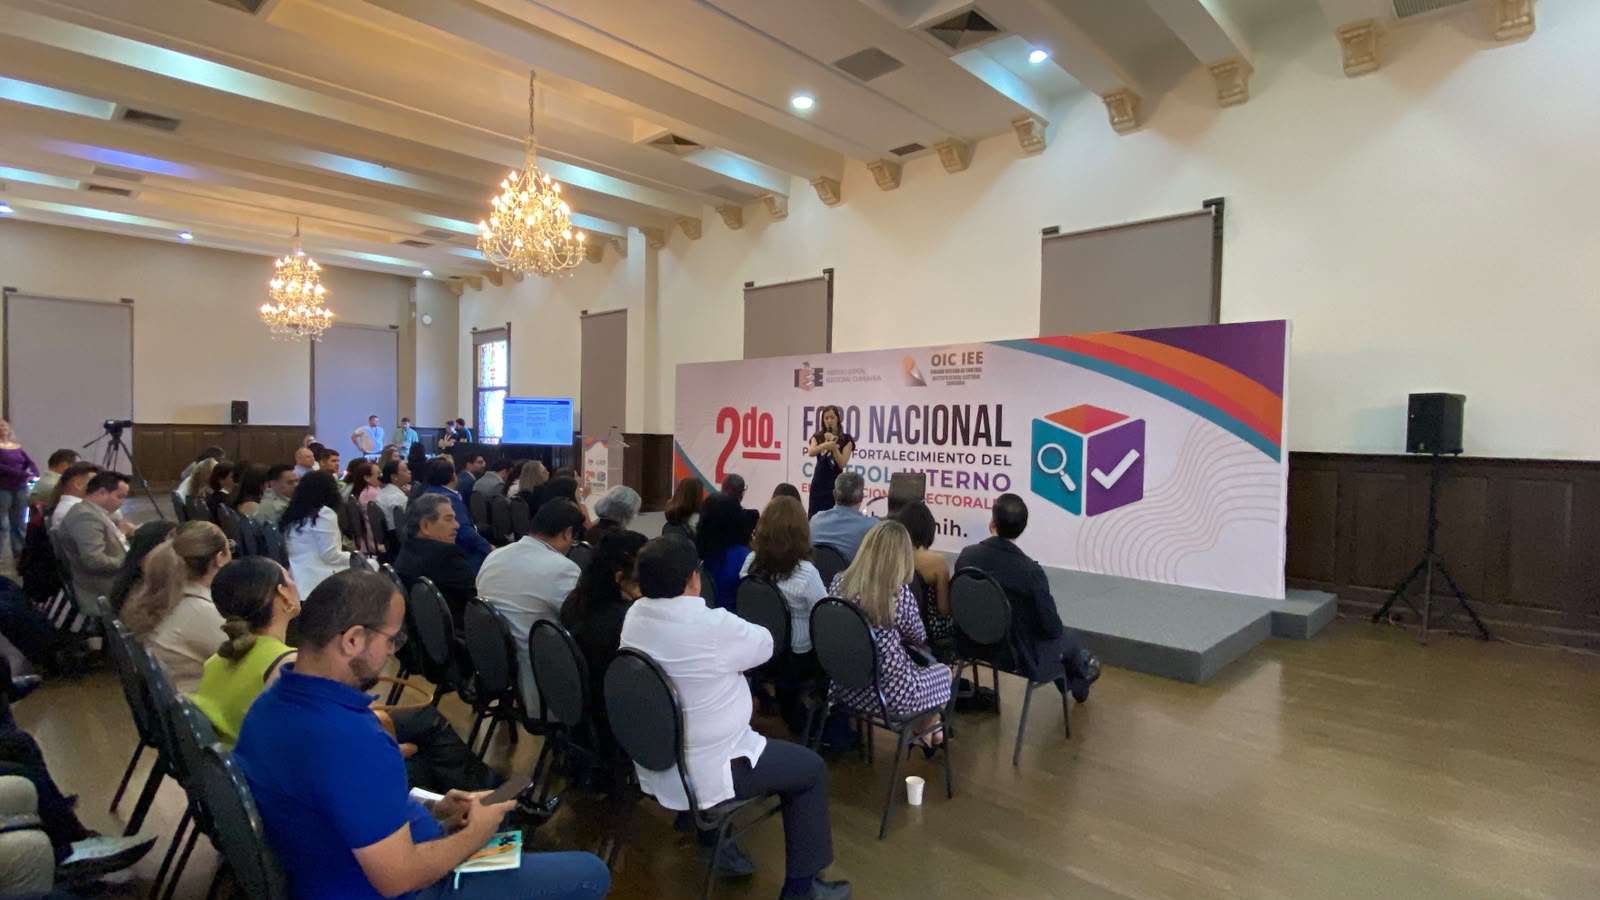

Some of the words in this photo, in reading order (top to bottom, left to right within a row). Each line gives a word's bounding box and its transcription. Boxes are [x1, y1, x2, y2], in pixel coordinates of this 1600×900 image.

[931, 353, 957, 367] OIC
[961, 351, 984, 365] IEE
[869, 404, 1012, 448] NACIONAL
[715, 406, 781, 485] 2do.
[852, 449, 976, 465] FORTALECIMIENTO
[981, 453, 1012, 466] DEL
[903, 468, 1011, 492] TERNO
